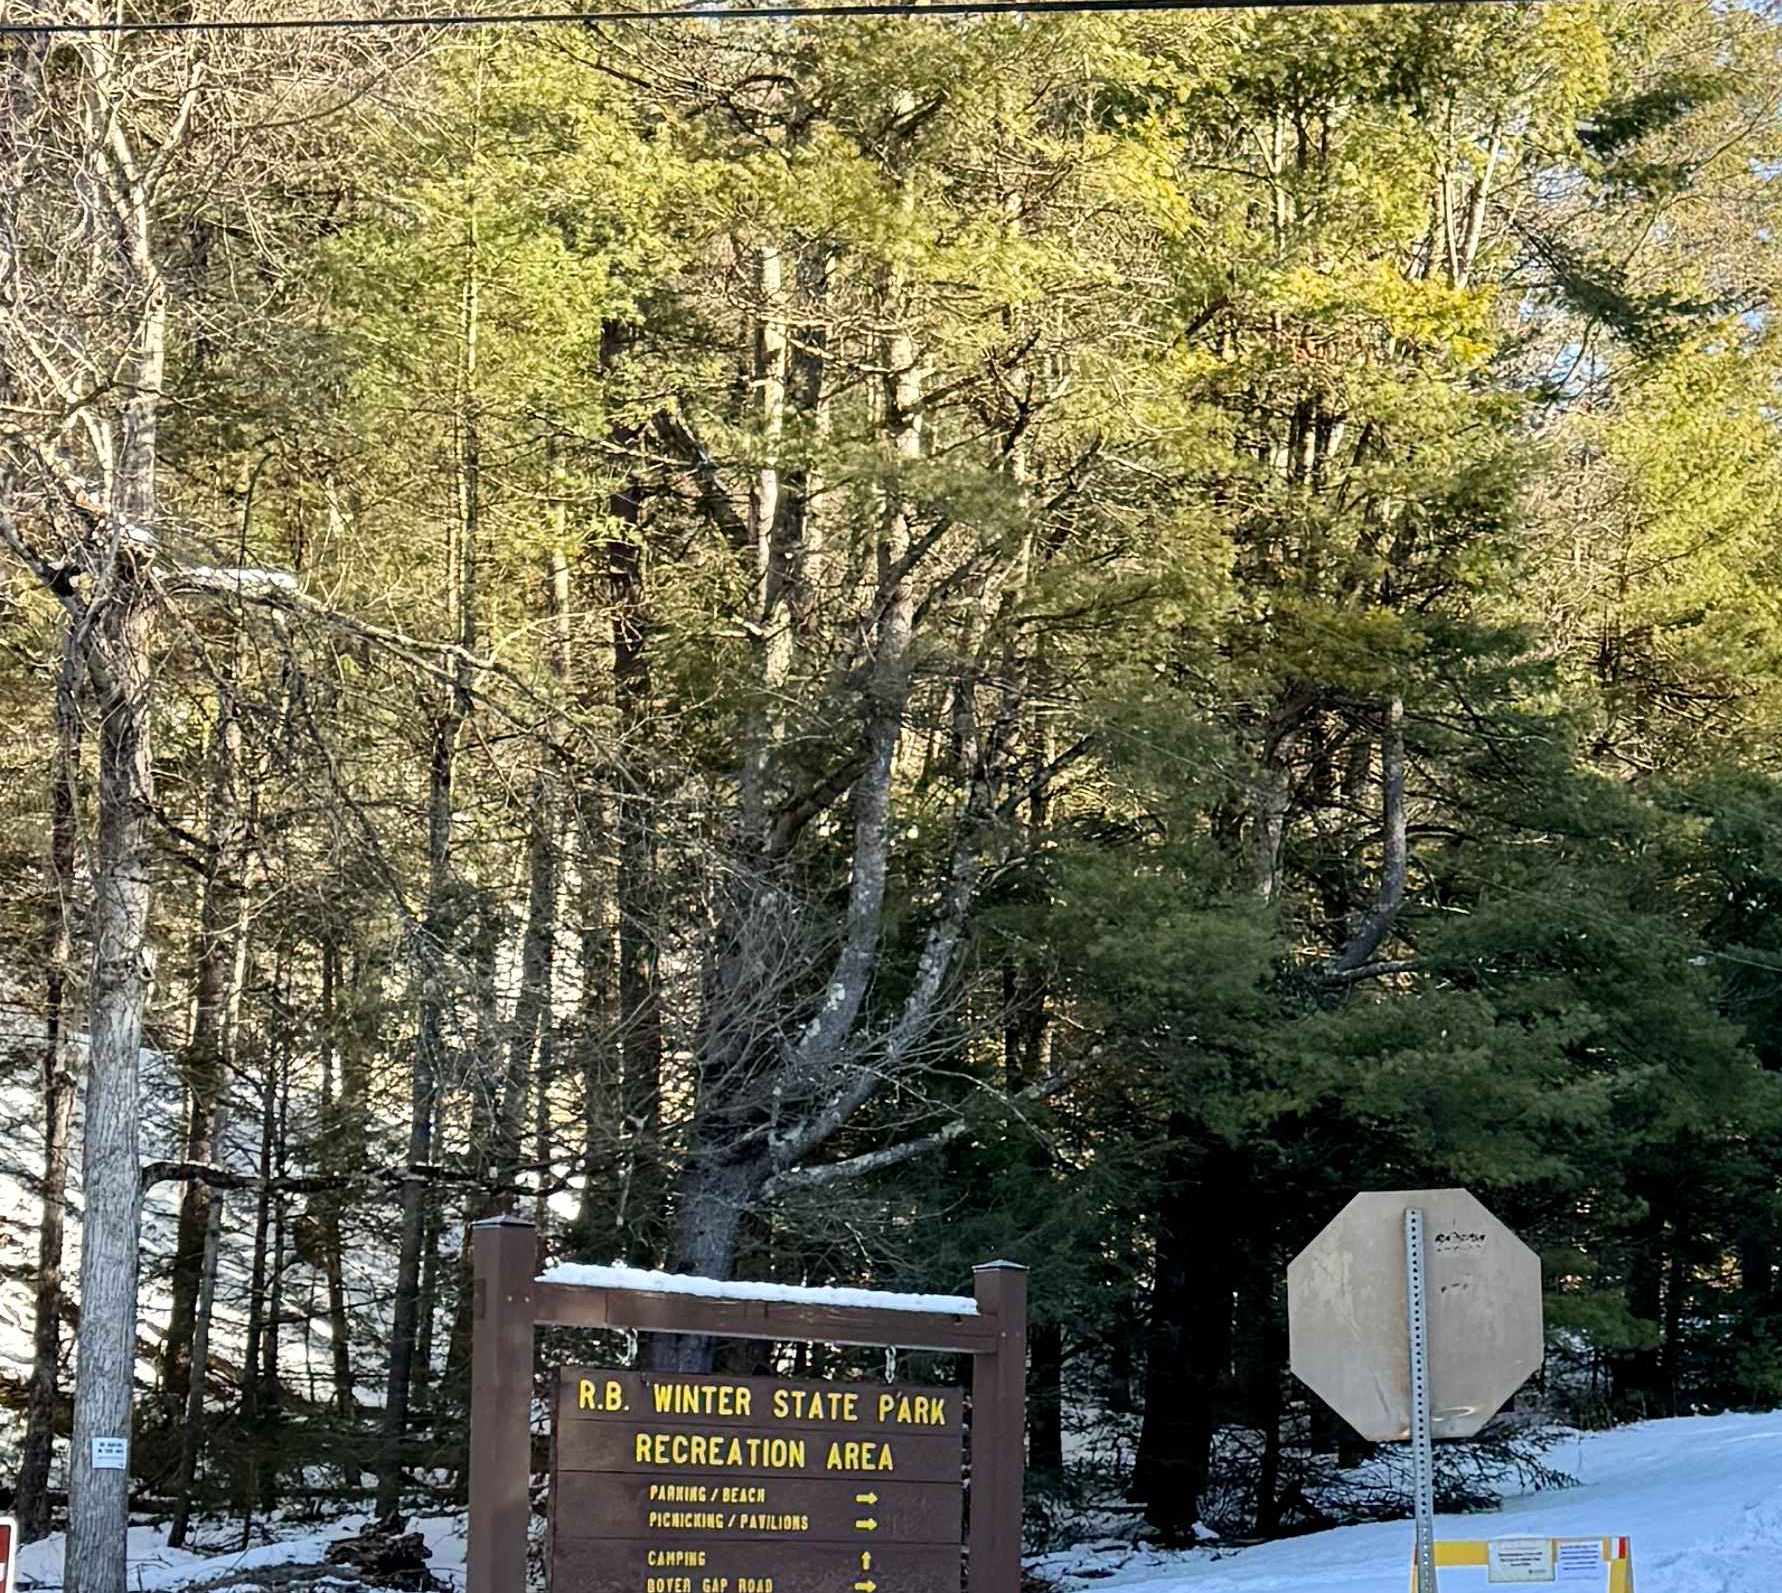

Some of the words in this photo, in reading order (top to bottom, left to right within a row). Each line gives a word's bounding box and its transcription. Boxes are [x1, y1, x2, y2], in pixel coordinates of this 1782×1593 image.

[577, 1378, 630, 1411] R.B.
[653, 1383, 751, 1416] WINTER
[773, 1388, 859, 1421] STATE
[879, 1393, 946, 1425] PARK
[635, 1433, 806, 1468] RECREATION
[826, 1441, 894, 1471] AREA
[650, 1484, 706, 1503] PARKING
[722, 1487, 765, 1503] BEACH
[648, 1511, 724, 1529] PICNICKING
[740, 1513, 809, 1531] PAVILIONS
[647, 1550, 706, 1567] CAMPING
[702, 1578, 728, 1593] GAP
[738, 1578, 773, 1593] ROAD
